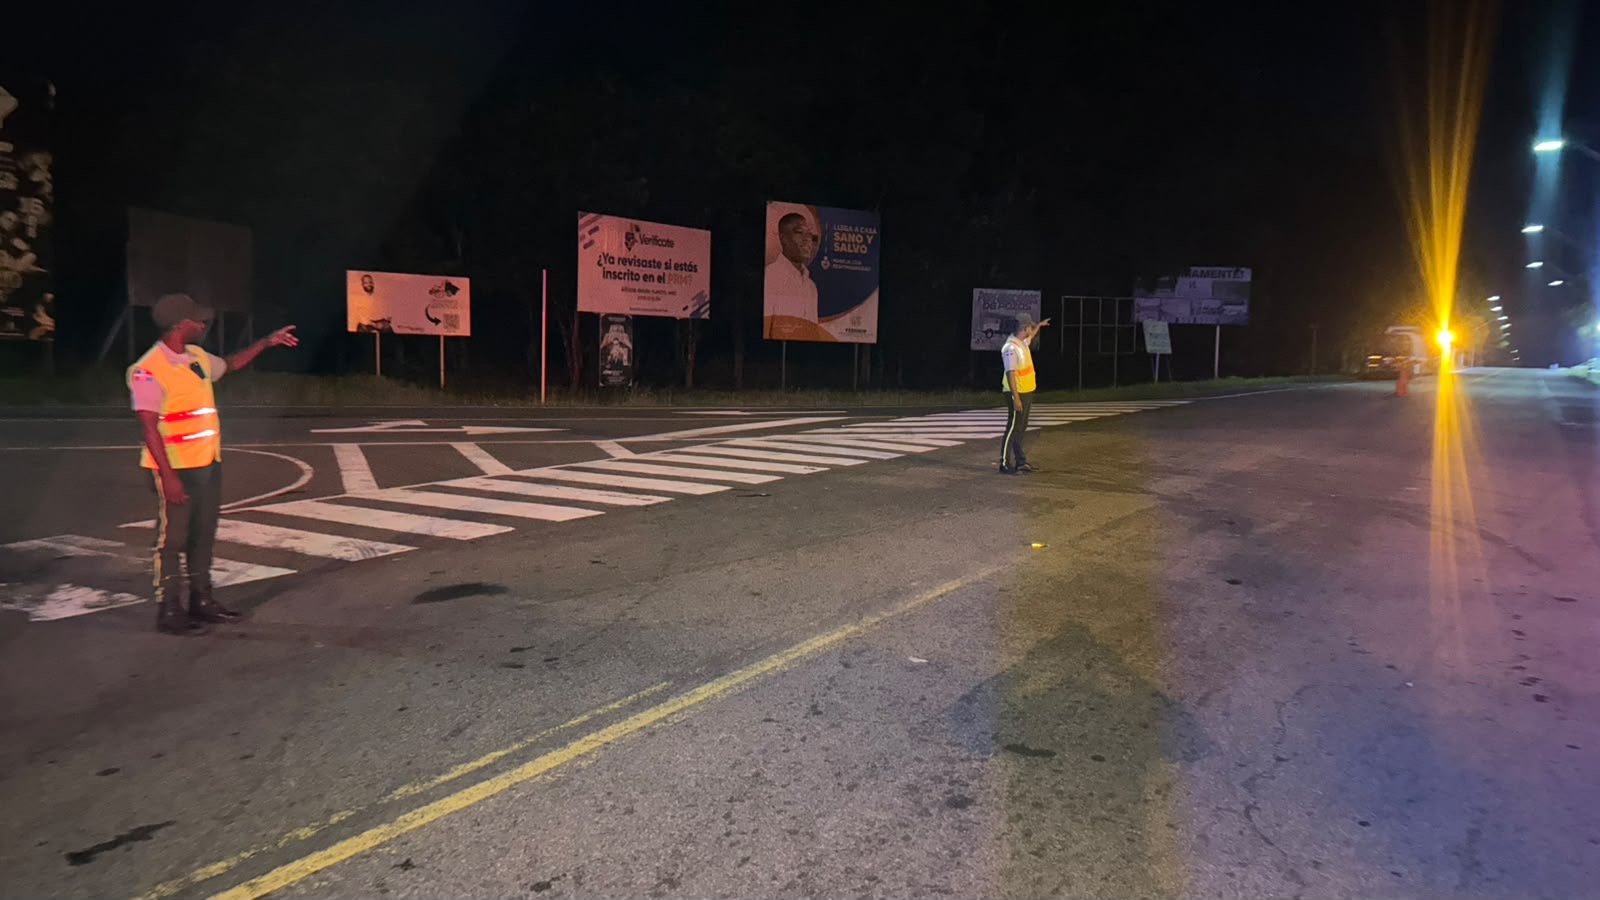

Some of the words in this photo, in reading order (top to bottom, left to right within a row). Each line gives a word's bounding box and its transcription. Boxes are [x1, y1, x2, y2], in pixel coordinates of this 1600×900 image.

[834, 231, 864, 244] SANO
[866, 234, 874, 244] Y
[834, 242, 868, 254] SALVO
[597, 252, 615, 267] ¿Ya
[617, 255, 663, 269] revisaste
[664, 258, 672, 270] si
[673, 261, 698, 273] estás
[602, 267, 640, 282] inscrito
[642, 273, 655, 283] en
[657, 272, 666, 284] el
